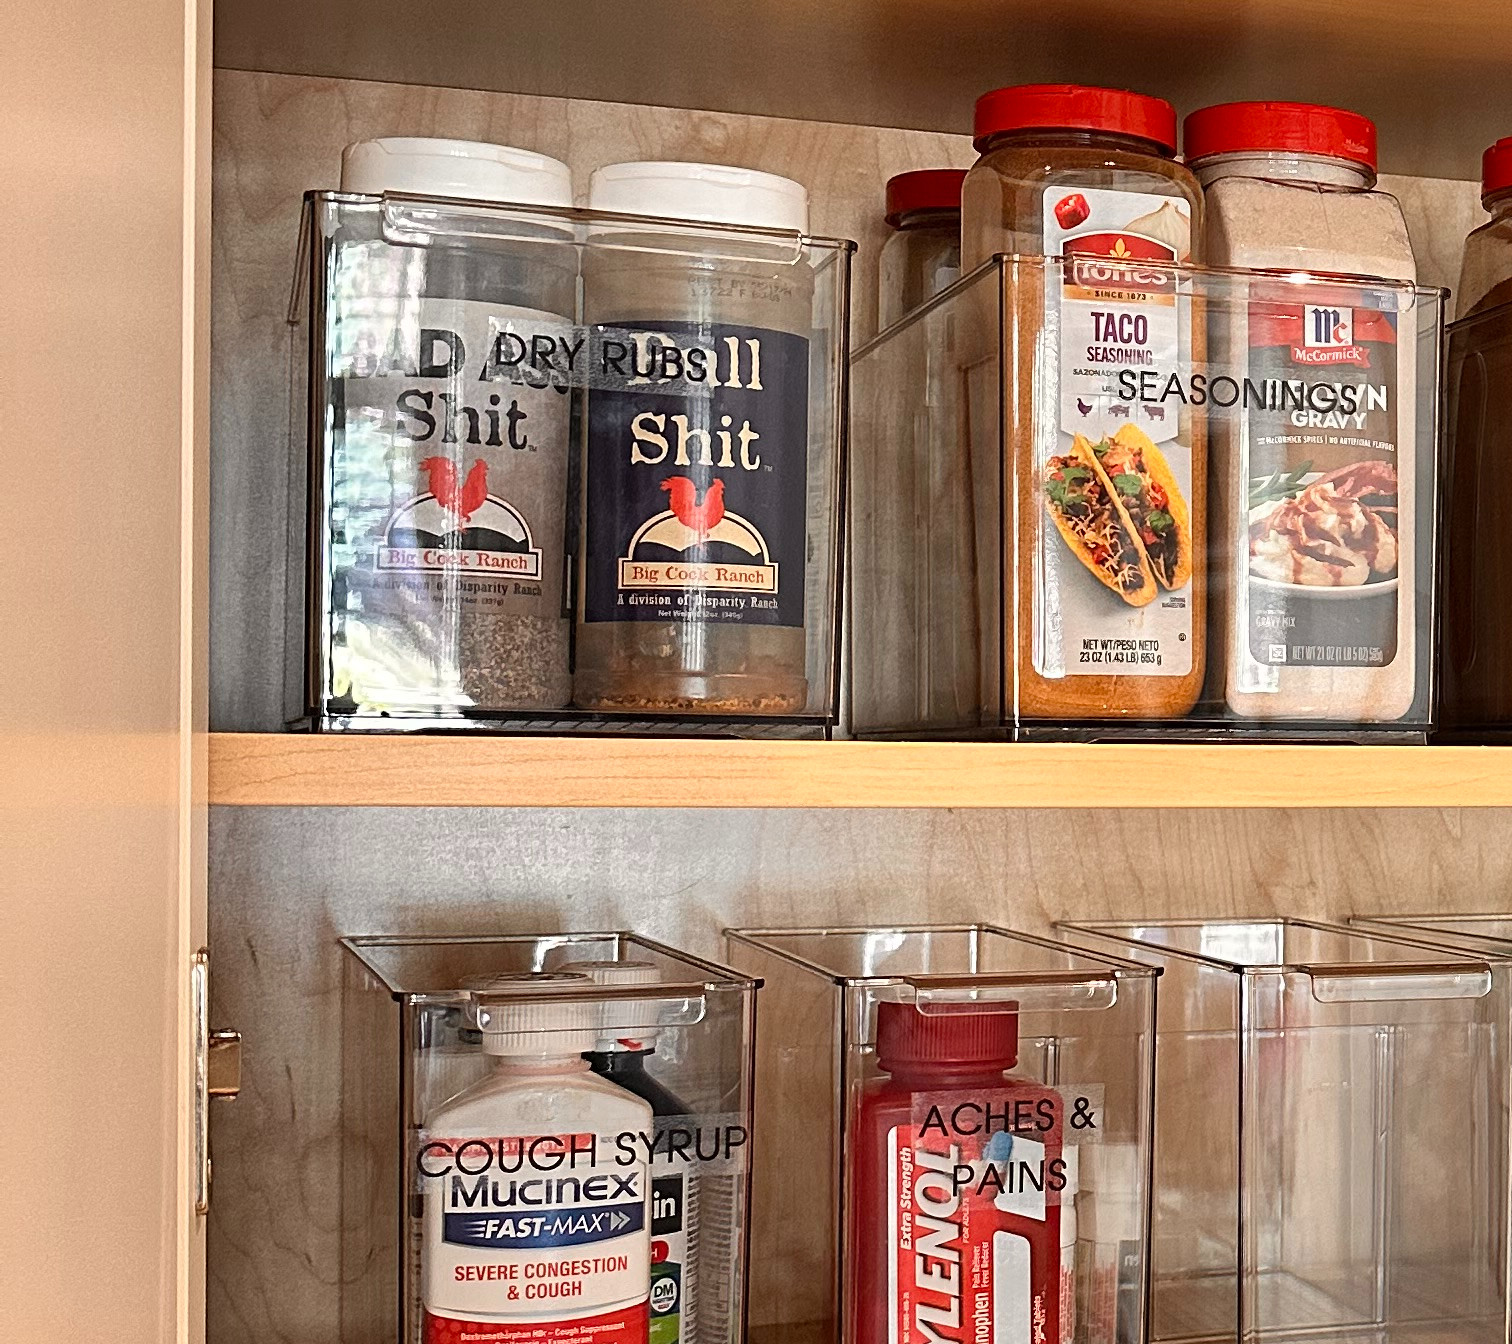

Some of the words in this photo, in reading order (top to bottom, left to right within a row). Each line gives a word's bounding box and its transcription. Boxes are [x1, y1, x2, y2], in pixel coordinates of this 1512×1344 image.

[1091, 312, 1147, 345] TACO
[496, 331, 587, 372] DRY
[602, 340, 708, 383] RUBS
[1087, 347, 1152, 365] SEASONING
[1294, 348, 1361, 361] McCormick
[1117, 369, 1356, 416] SEASONINGS
[396, 388, 529, 450] Shit
[1291, 410, 1366, 429] GRAVY
[631, 411, 761, 469] Shit
[423, 551, 469, 567] Cock
[477, 553, 529, 570] Ranch
[632, 566, 659, 583] Big
[666, 566, 703, 582] Cock
[708, 567, 765, 584] Ranch
[629, 594, 673, 607] division
[919, 1099, 1054, 1137] ACHES
[1071, 1097, 1096, 1130] &
[418, 1133, 597, 1178] COUGH
[615, 1126, 747, 1166] SYRUP
[901, 1147, 911, 1204] Strength
[951, 1160, 1067, 1197] PAINS
[484, 1214, 603, 1239] FAST-MAX
[901, 1207, 911, 1249] Extra
[455, 1265, 518, 1283] SEVERE
[524, 1256, 628, 1278] CONGESTION
[507, 1285, 520, 1300] &
[525, 1281, 582, 1298] COUGH
